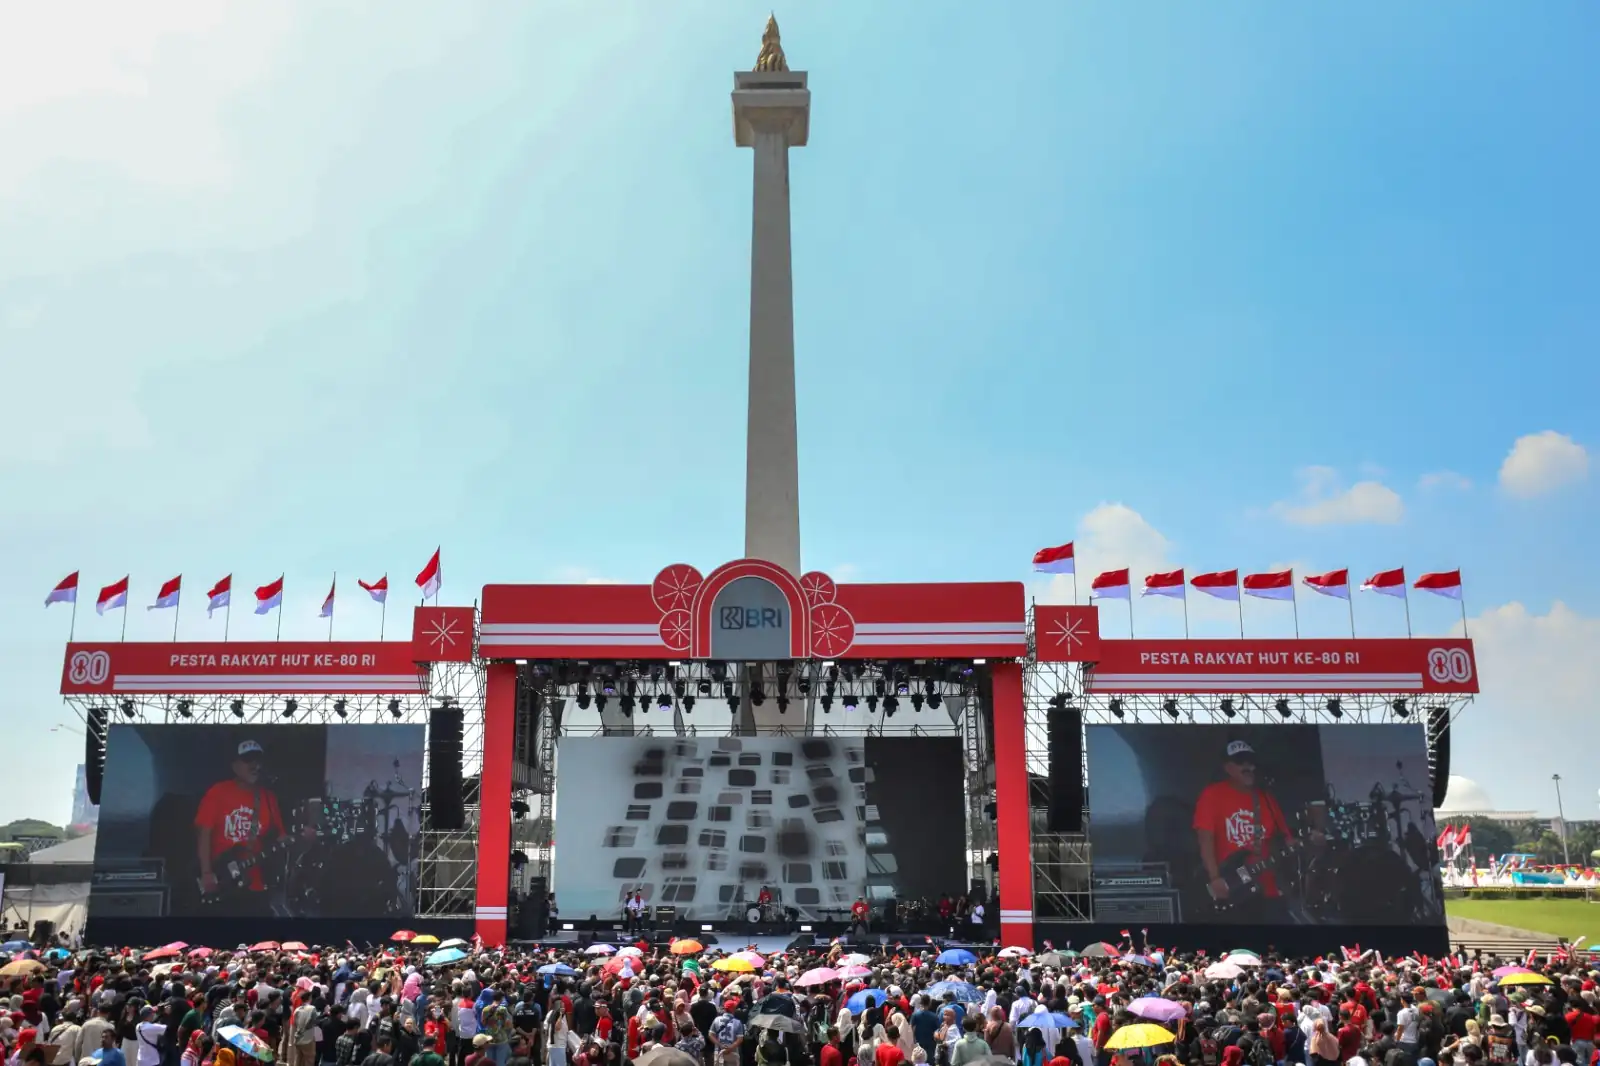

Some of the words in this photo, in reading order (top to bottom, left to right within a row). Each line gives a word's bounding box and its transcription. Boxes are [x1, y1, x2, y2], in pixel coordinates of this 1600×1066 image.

[745, 607, 783, 629] BRI
[69, 650, 111, 685] 80
[170, 654, 217, 667] PESTA
[220, 654, 277, 667] RAKYAT
[281, 654, 311, 667] HUT
[313, 654, 358, 667] KE-80
[361, 654, 376, 667] RI
[1140, 652, 1190, 665] PESTA
[1194, 652, 1254, 665] RAKYAT
[1258, 652, 1289, 665] HUT
[1293, 652, 1341, 665] KE-80
[1345, 652, 1360, 665] RI
[1427, 647, 1473, 684] 80
